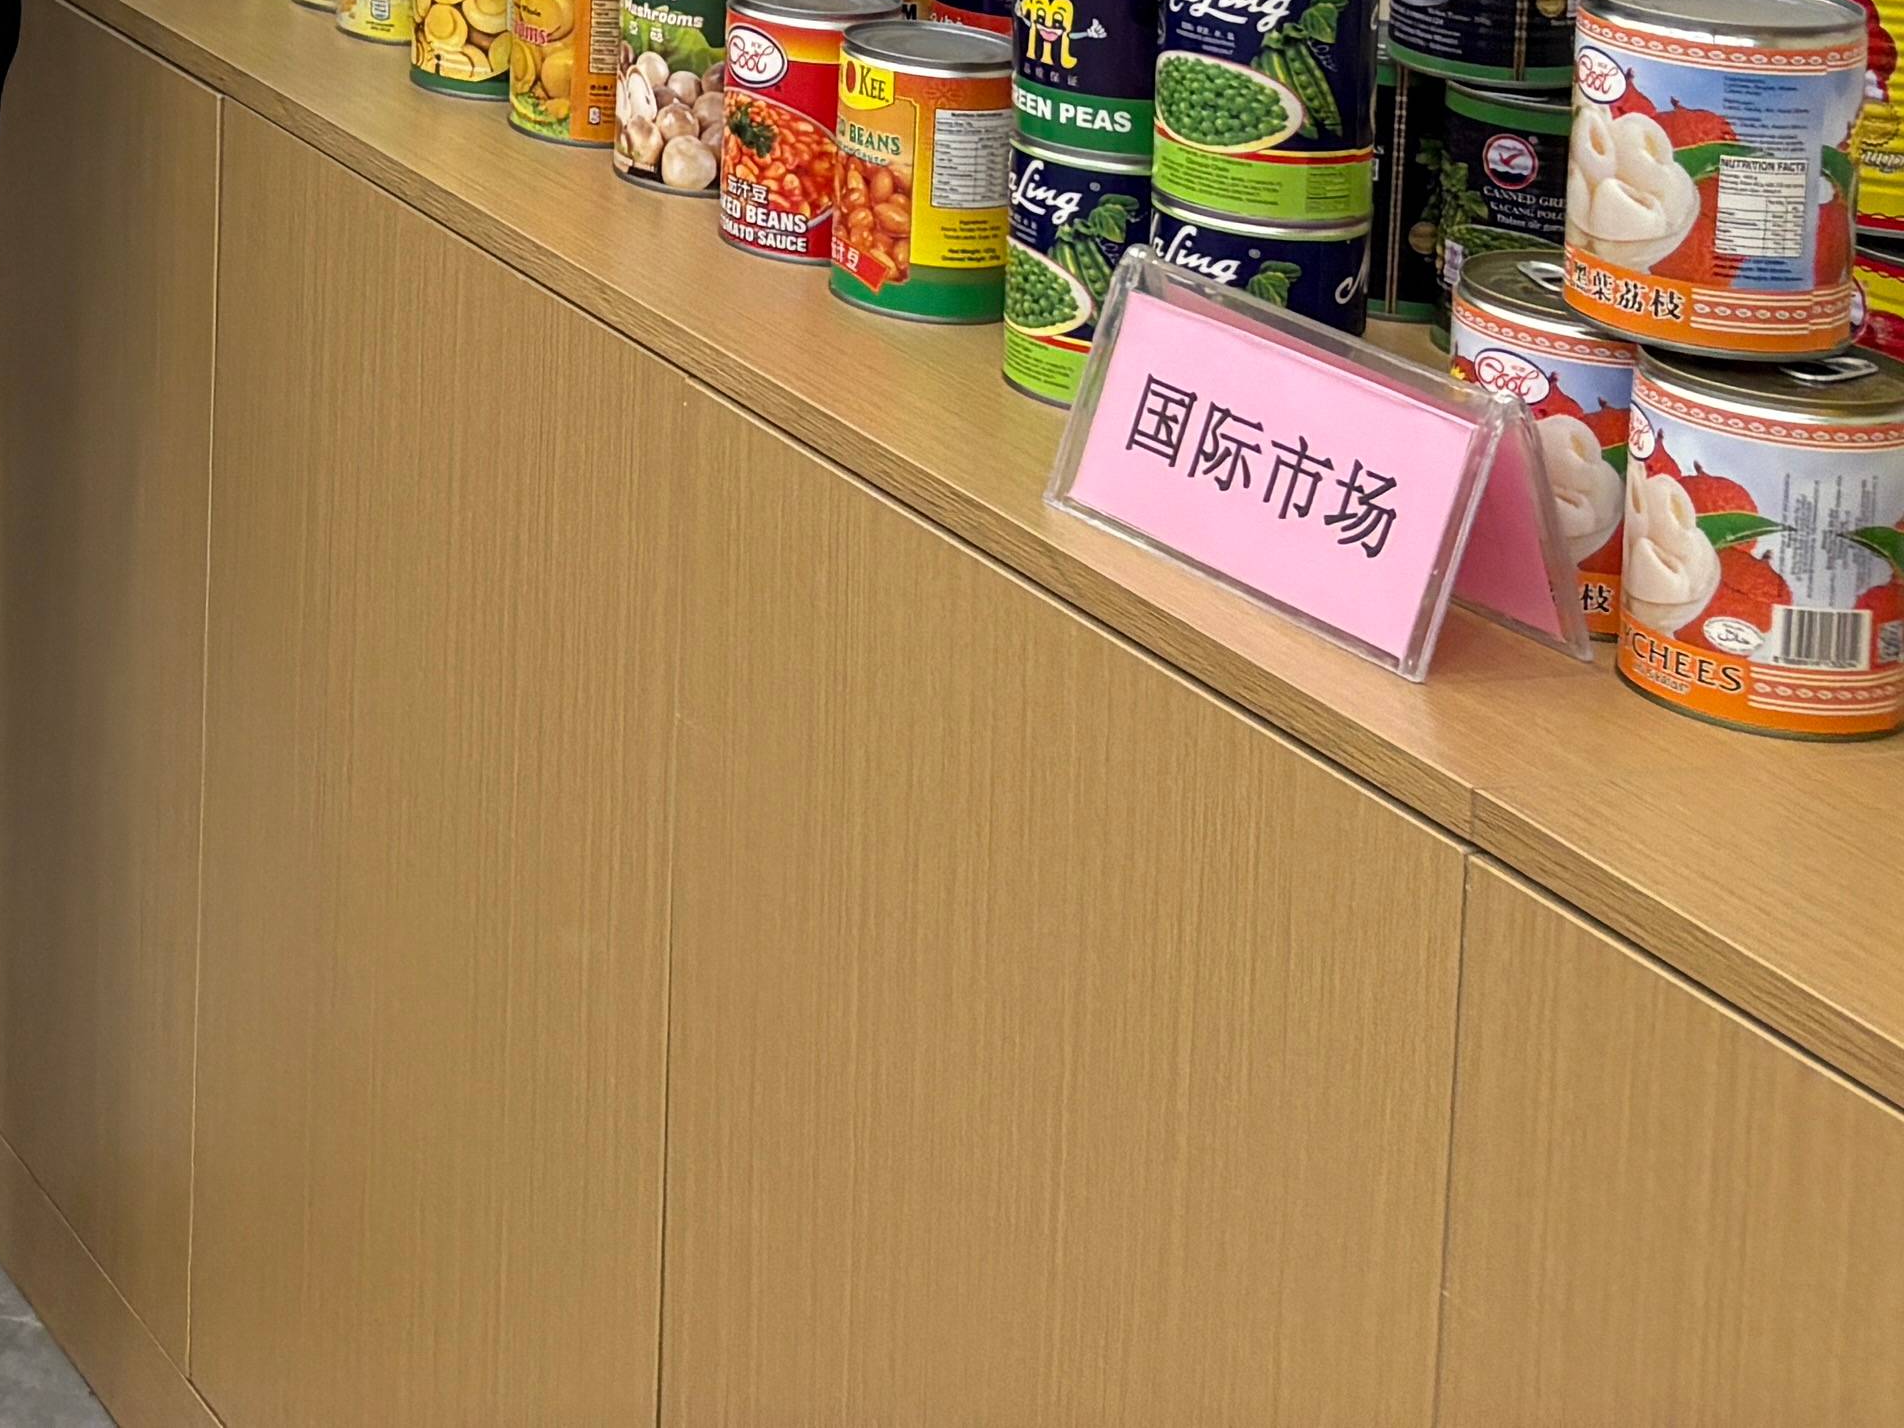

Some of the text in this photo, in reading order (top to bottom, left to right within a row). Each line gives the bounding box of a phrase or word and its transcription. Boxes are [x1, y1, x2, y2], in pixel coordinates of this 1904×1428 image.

[1059, 102, 1132, 133] PEAS
[849, 123, 901, 156] BEANS
[1720, 158, 1806, 173] NUTRITION FACTS
[1008, 159, 1083, 226] aLing
[1539, 196, 1566, 208] GRE
[721, 195, 808, 234] KED BEANS
[721, 215, 808, 253] MATO SAUCE
[1153, 225, 1241, 285] aLing
[1125, 372, 1398, 559] 国际市场
[1624, 622, 1742, 692] YCHEES
